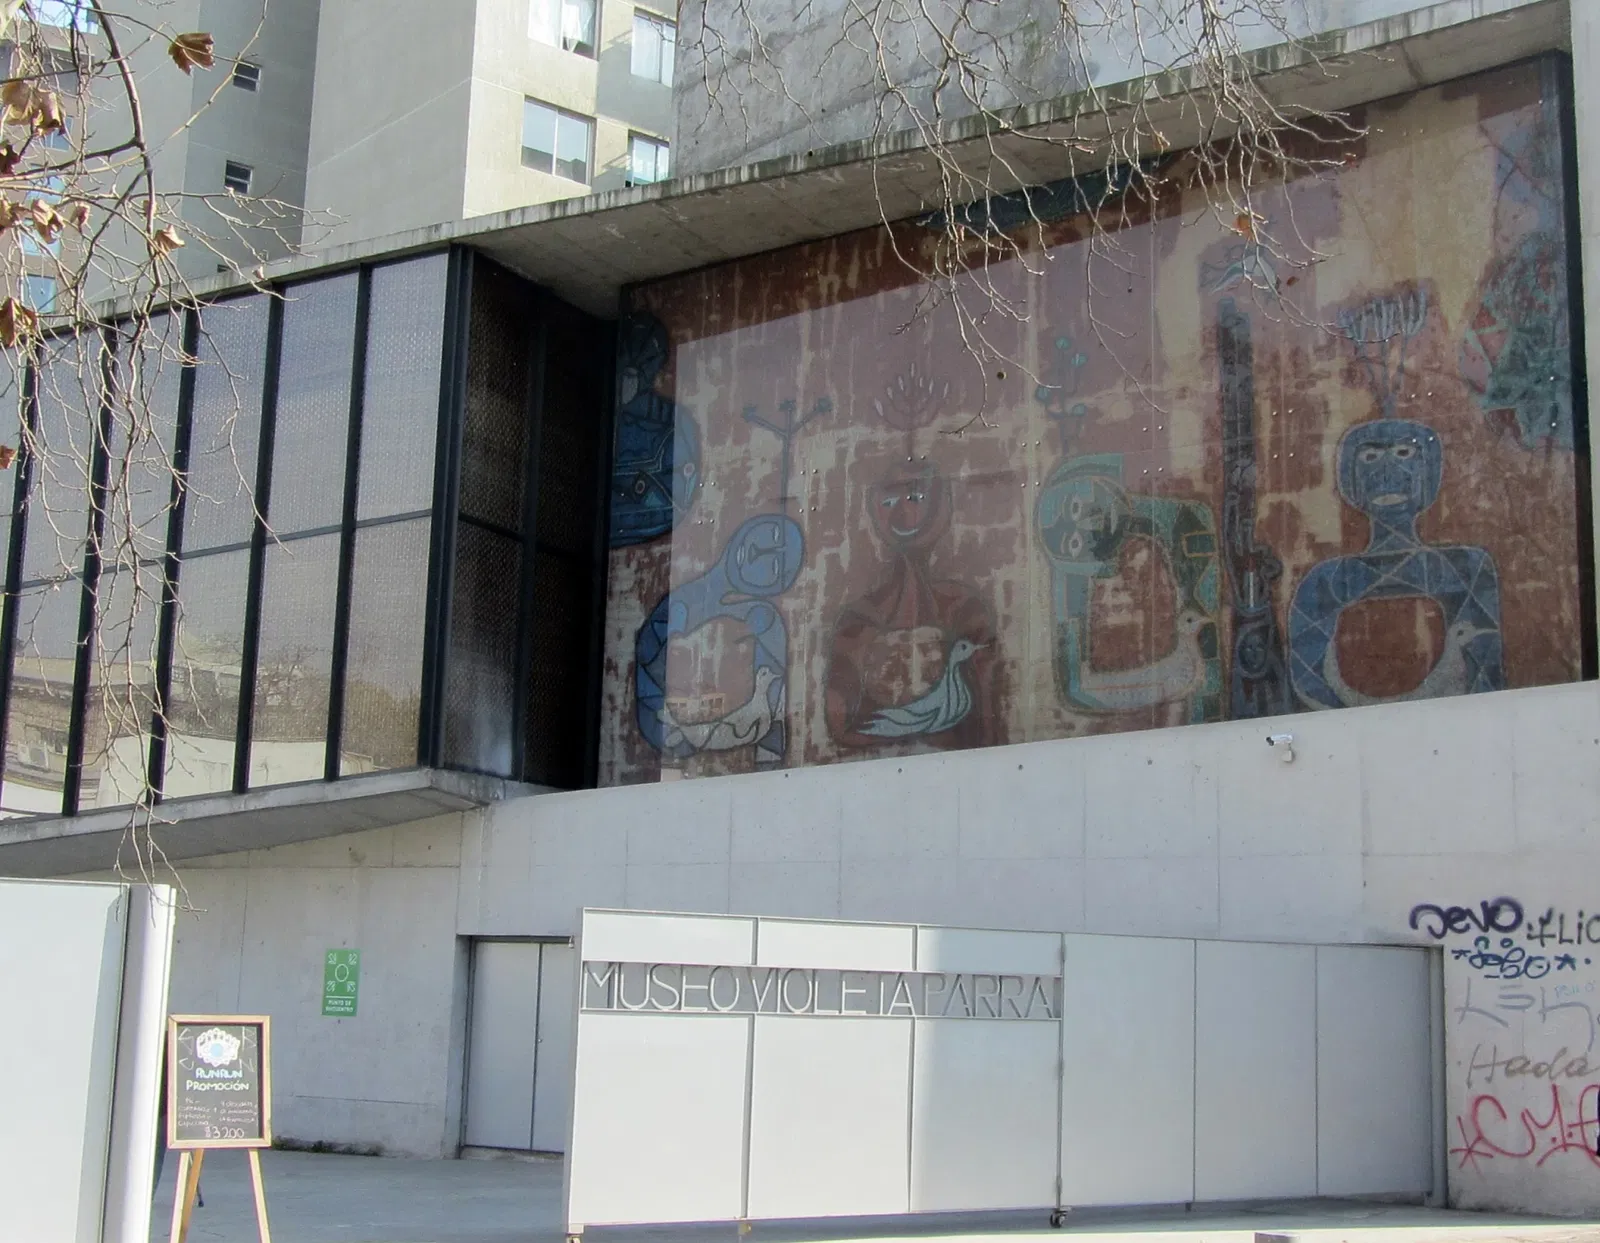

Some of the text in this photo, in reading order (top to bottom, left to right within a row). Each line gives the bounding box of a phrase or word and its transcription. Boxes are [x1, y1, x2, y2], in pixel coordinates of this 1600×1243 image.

[582, 961, 1053, 1019] MUSEO VIOLETA PARRA
